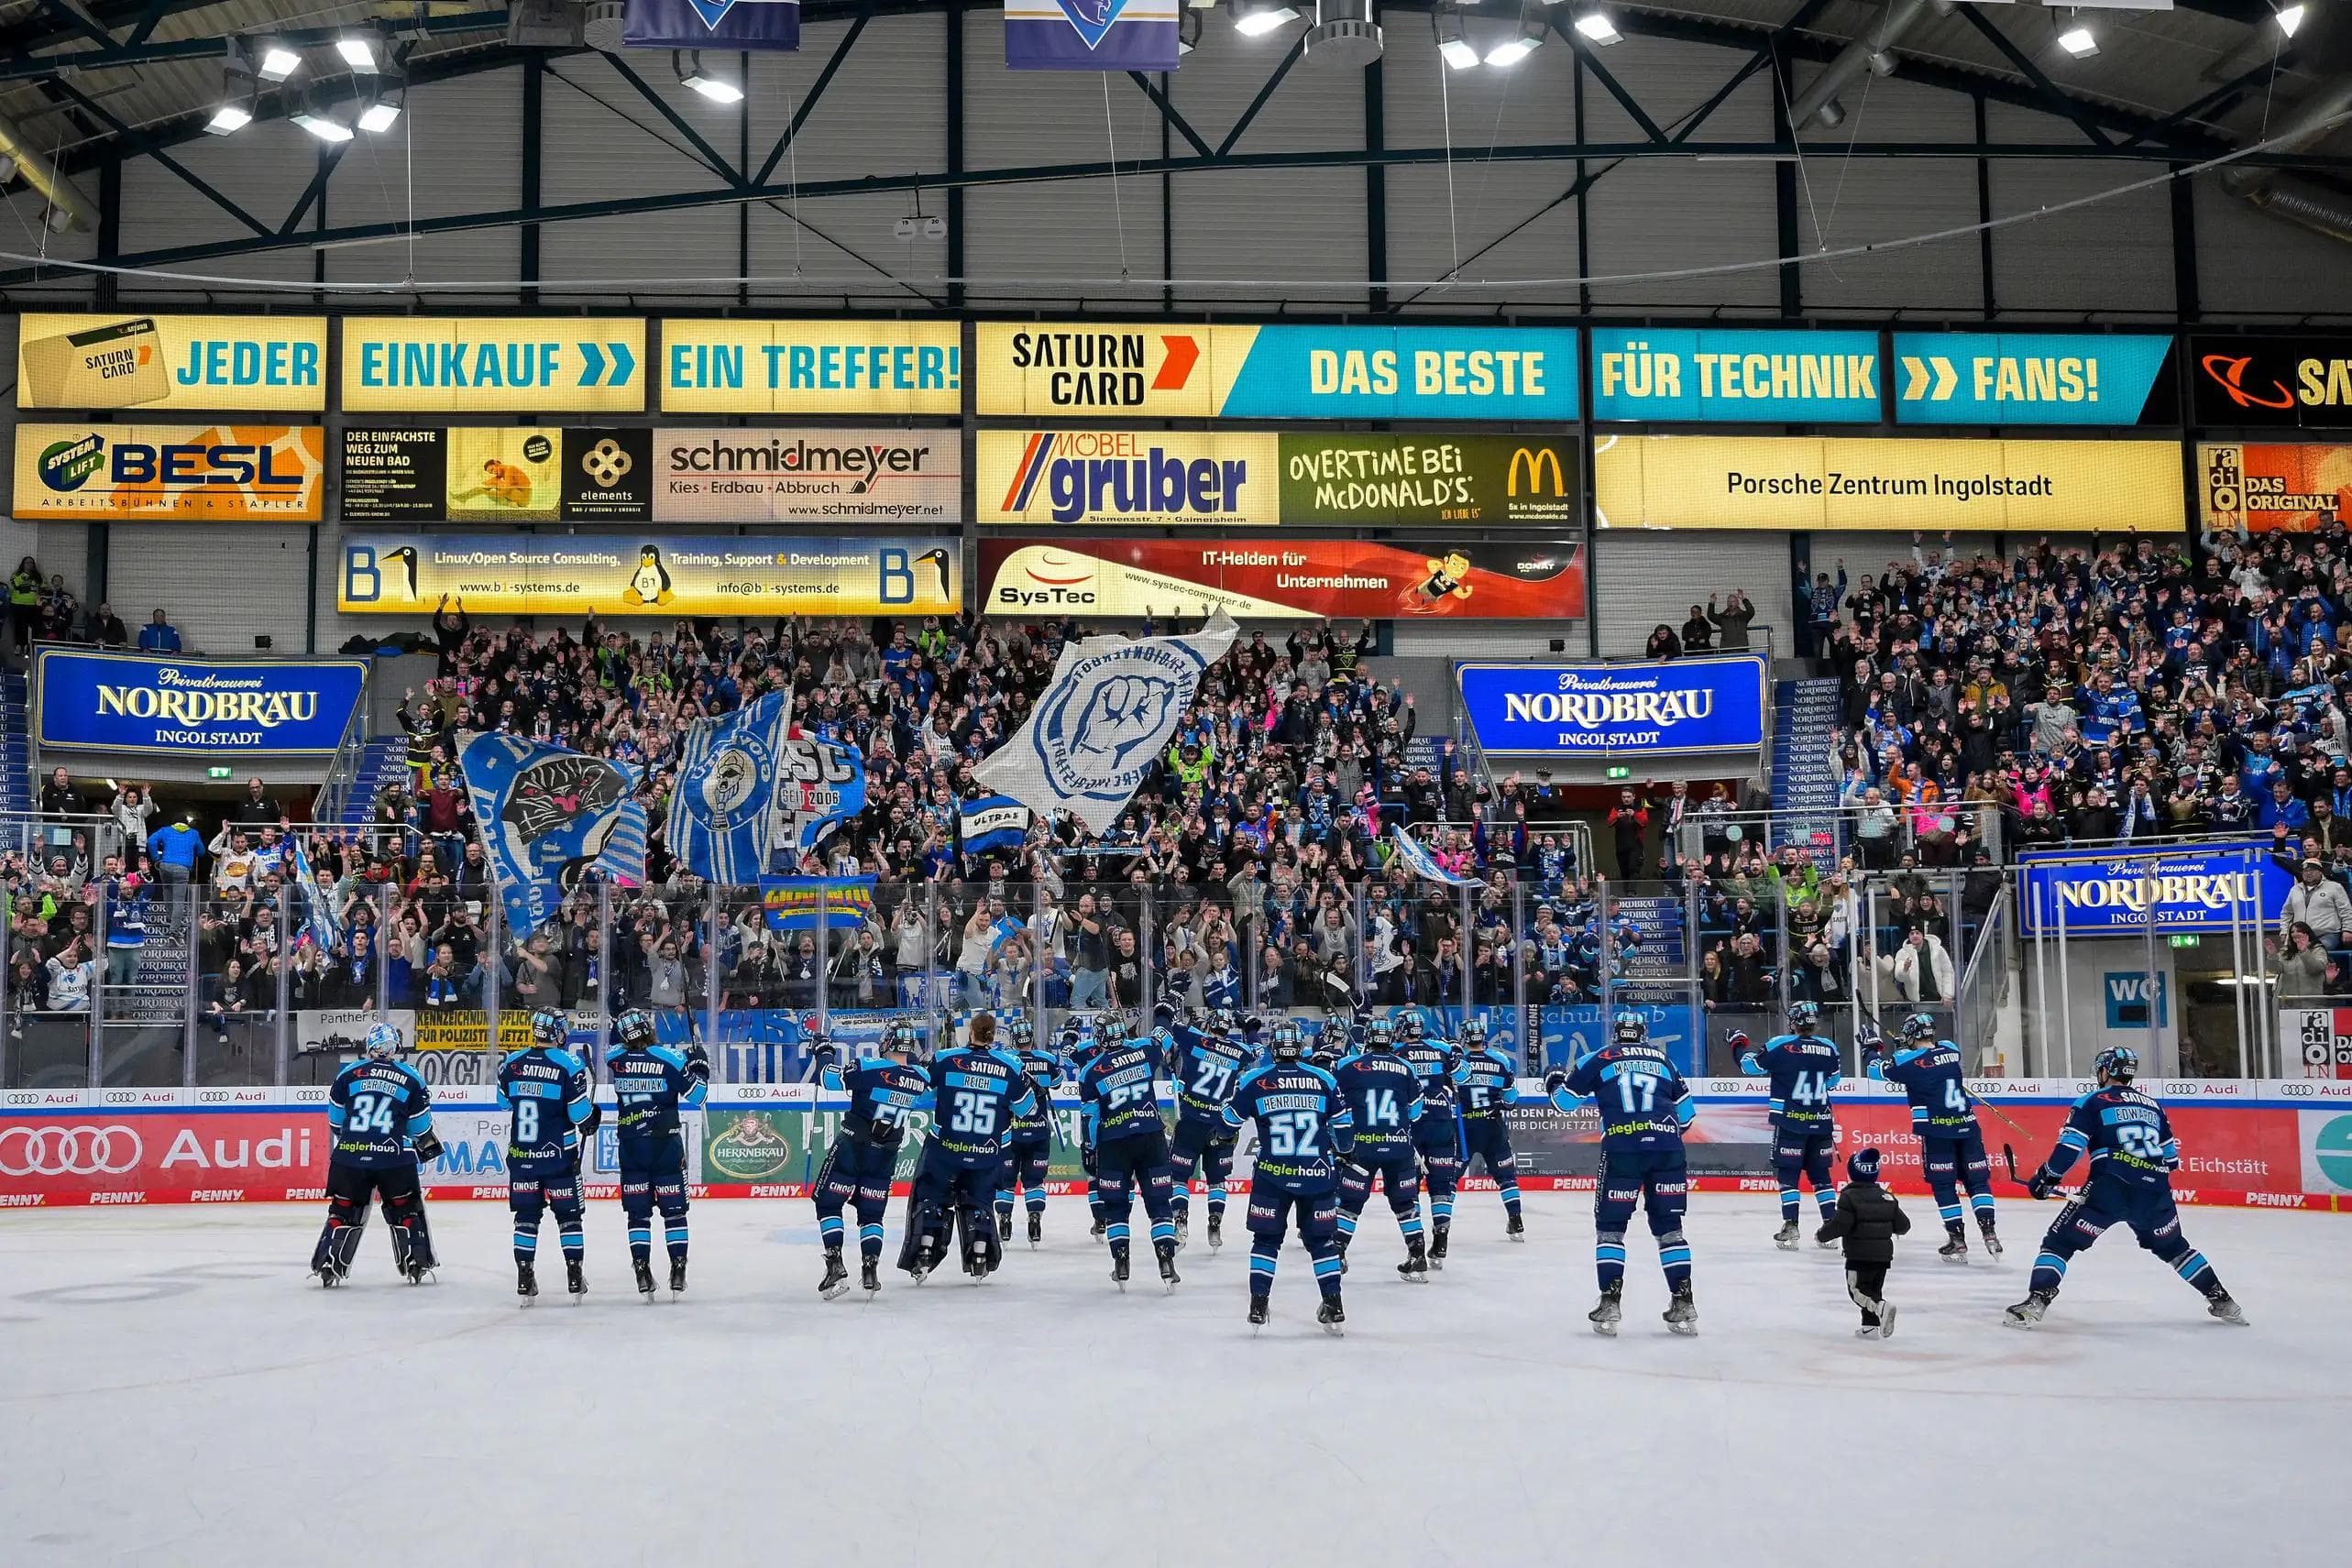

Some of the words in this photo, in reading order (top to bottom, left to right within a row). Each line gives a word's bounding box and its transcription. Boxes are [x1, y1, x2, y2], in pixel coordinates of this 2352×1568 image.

[1013, 333, 1144, 368] SATURN
[85, 348, 133, 370] SATURN
[177, 341, 318, 386] JEDER
[361, 342, 560, 388] EINKAUF
[671, 345, 743, 389] EIN
[762, 345, 960, 389] TREFFER!
[102, 362, 135, 379] CARD
[1311, 349, 1398, 395] DAS
[1415, 350, 1544, 396] BESTE
[1602, 342, 1680, 399] FÜR
[1694, 352, 1876, 400] TECHNIK
[1973, 357, 2098, 401] FANS!
[1050, 371, 1144, 406] CARD
[347, 432, 368, 442] DER
[371, 432, 435, 443] EINFACHSTE
[1055, 433, 1144, 457] MÖBEL
[48, 439, 96, 470] SYSTEM
[346, 444, 371, 455] WEG
[374, 444, 398, 454] ZUM
[70, 457, 95, 477] LIFT
[111, 444, 303, 485] BESL
[346, 455, 383, 466] NEUEN
[387, 455, 410, 466] BAD
[670, 440, 929, 482] schmidmeyer
[669, 480, 699, 494] Kies
[710, 479, 764, 494] Erdbau
[775, 479, 840, 494] Abbruch
[1050, 448, 1246, 523] gruber
[1728, 472, 1822, 495] Porsche
[1829, 473, 1927, 496] Zentrum
[1934, 474, 2053, 501] Ingolstadt
[2246, 478, 2284, 493] DAS
[581, 490, 632, 500] elements
[2247, 495, 2339, 510] ORIGINAL
[228, 499, 303, 509] STAPLER
[788, 502, 943, 518] www.schmidmeyer.net
[1509, 503, 1518, 511] 5x
[1530, 503, 1568, 512] Ingolstadt
[434, 552, 506, 565] Linux/Open
[510, 553, 550, 565] Source
[553, 552, 621, 566] Consulting,
[671, 554, 722, 566] Training,
[724, 554, 773, 566] Support
[777, 554, 786, 565] &
[790, 554, 870, 566] Development
[1203, 551, 1277, 566] IT-Helden
[1282, 551, 1306, 566] für
[460, 581, 579, 594] www.b1-systems.de
[717, 582, 840, 596] info@b1-systems.de
[1277, 574, 1388, 590] Unternehmen
[1000, 587, 1095, 606] SysTec
[1125, 571, 1252, 610] www.systec-computer.de
[159, 667, 264, 689] Privatbrauerei
[1558, 673, 1658, 691] Privatbrauerei
[95, 685, 320, 728] NORDBRÄU
[1504, 688, 1715, 729] NORDBRÄU
[155, 729, 263, 745] INGOLSTADT
[1559, 730, 1660, 746] INGOLSTADT
[809, 791, 840, 805] 2006
[973, 812, 1018, 827] ULTRAS
[2109, 979, 2160, 1001] WC
[321, 1012, 368, 1025] Panther
[418, 1027, 436, 1042] FÜR
[500, 1029, 529, 1042] JETZT
[1529, 1029, 1537, 1054] EINS
[1214, 1043, 1244, 1058] SATURN
[1408, 1050, 1441, 1060] SATURN
[1621, 1047, 1665, 1060] SATURN
[1801, 1044, 1830, 1057] SATURN
[1111, 1049, 1146, 1069] SATURN
[522, 1063, 560, 1081] SATURN
[625, 1061, 664, 1075] SATURN
[971, 1060, 1007, 1077] SATURN
[1371, 1060, 1408, 1076] SATURN
[1470, 1062, 1500, 1073] SATURN
[1613, 1061, 1661, 1074] MATTEAU
[2304, 1065, 2330, 1079] IN
[370, 1068, 408, 1086] SATURN
[964, 1076, 990, 1091] REICH
[1105, 1067, 1148, 1089] FRIEDRICH
[1192, 1060, 1233, 1100] 27
[1278, 1077, 1321, 1091] SATURN
[360, 1079, 396, 1096] GARTEIG
[438, 1090, 467, 1100] Audi
[771, 1089, 801, 1097] Audi
[1617, 1071, 1658, 1113] 17
[1791, 1070, 1829, 1106] 44
[1945, 1078, 1966, 1112] 4
[2007, 1083, 2040, 1093] Audi
[2204, 1084, 2237, 1094] Audi
[46, 1094, 78, 1103] Audi
[142, 1092, 174, 1102] Audi
[235, 1091, 266, 1101] Audi
[1263, 1095, 1320, 1111] HENRIQUEZ
[2120, 1091, 2160, 1110] SATURN
[349, 1094, 394, 1135] 34
[951, 1091, 998, 1135] 35
[1365, 1088, 1400, 1127] 14
[1522, 1108, 1544, 1117] DEN
[1581, 1108, 1599, 1117] INS
[518, 1099, 539, 1143] 8
[1103, 1108, 1155, 1128] zieglerhaus
[2116, 1108, 2158, 1126] EDWARDS
[1530, 1121, 1557, 1130] DICH
[1561, 1121, 1598, 1130] JETZT!
[1607, 1120, 1676, 1136] zieglerhaus
[1269, 1111, 1321, 1157] 52
[1353, 1133, 1409, 1145] zieglerhaus
[160, 1128, 311, 1168] Audi
[338, 1140, 395, 1153] zieglerhaus
[718, 1147, 784, 1157] HERRNBRÄU
[941, 1138, 995, 1155] zieglerhaus
[1780, 1147, 1802, 1156] CINQUE
[1258, 1159, 1325, 1177] zieglerhaus
[1429, 1156, 1453, 1165] CINQUE
[1930, 1162, 1954, 1170] CINQUE
[2190, 1157, 2268, 1175] Eichstätt
[1342, 1177, 1366, 1190] CINQUE
[1655, 1183, 1686, 1193] CINQUE
[861, 1186, 886, 1199] CINQUE
